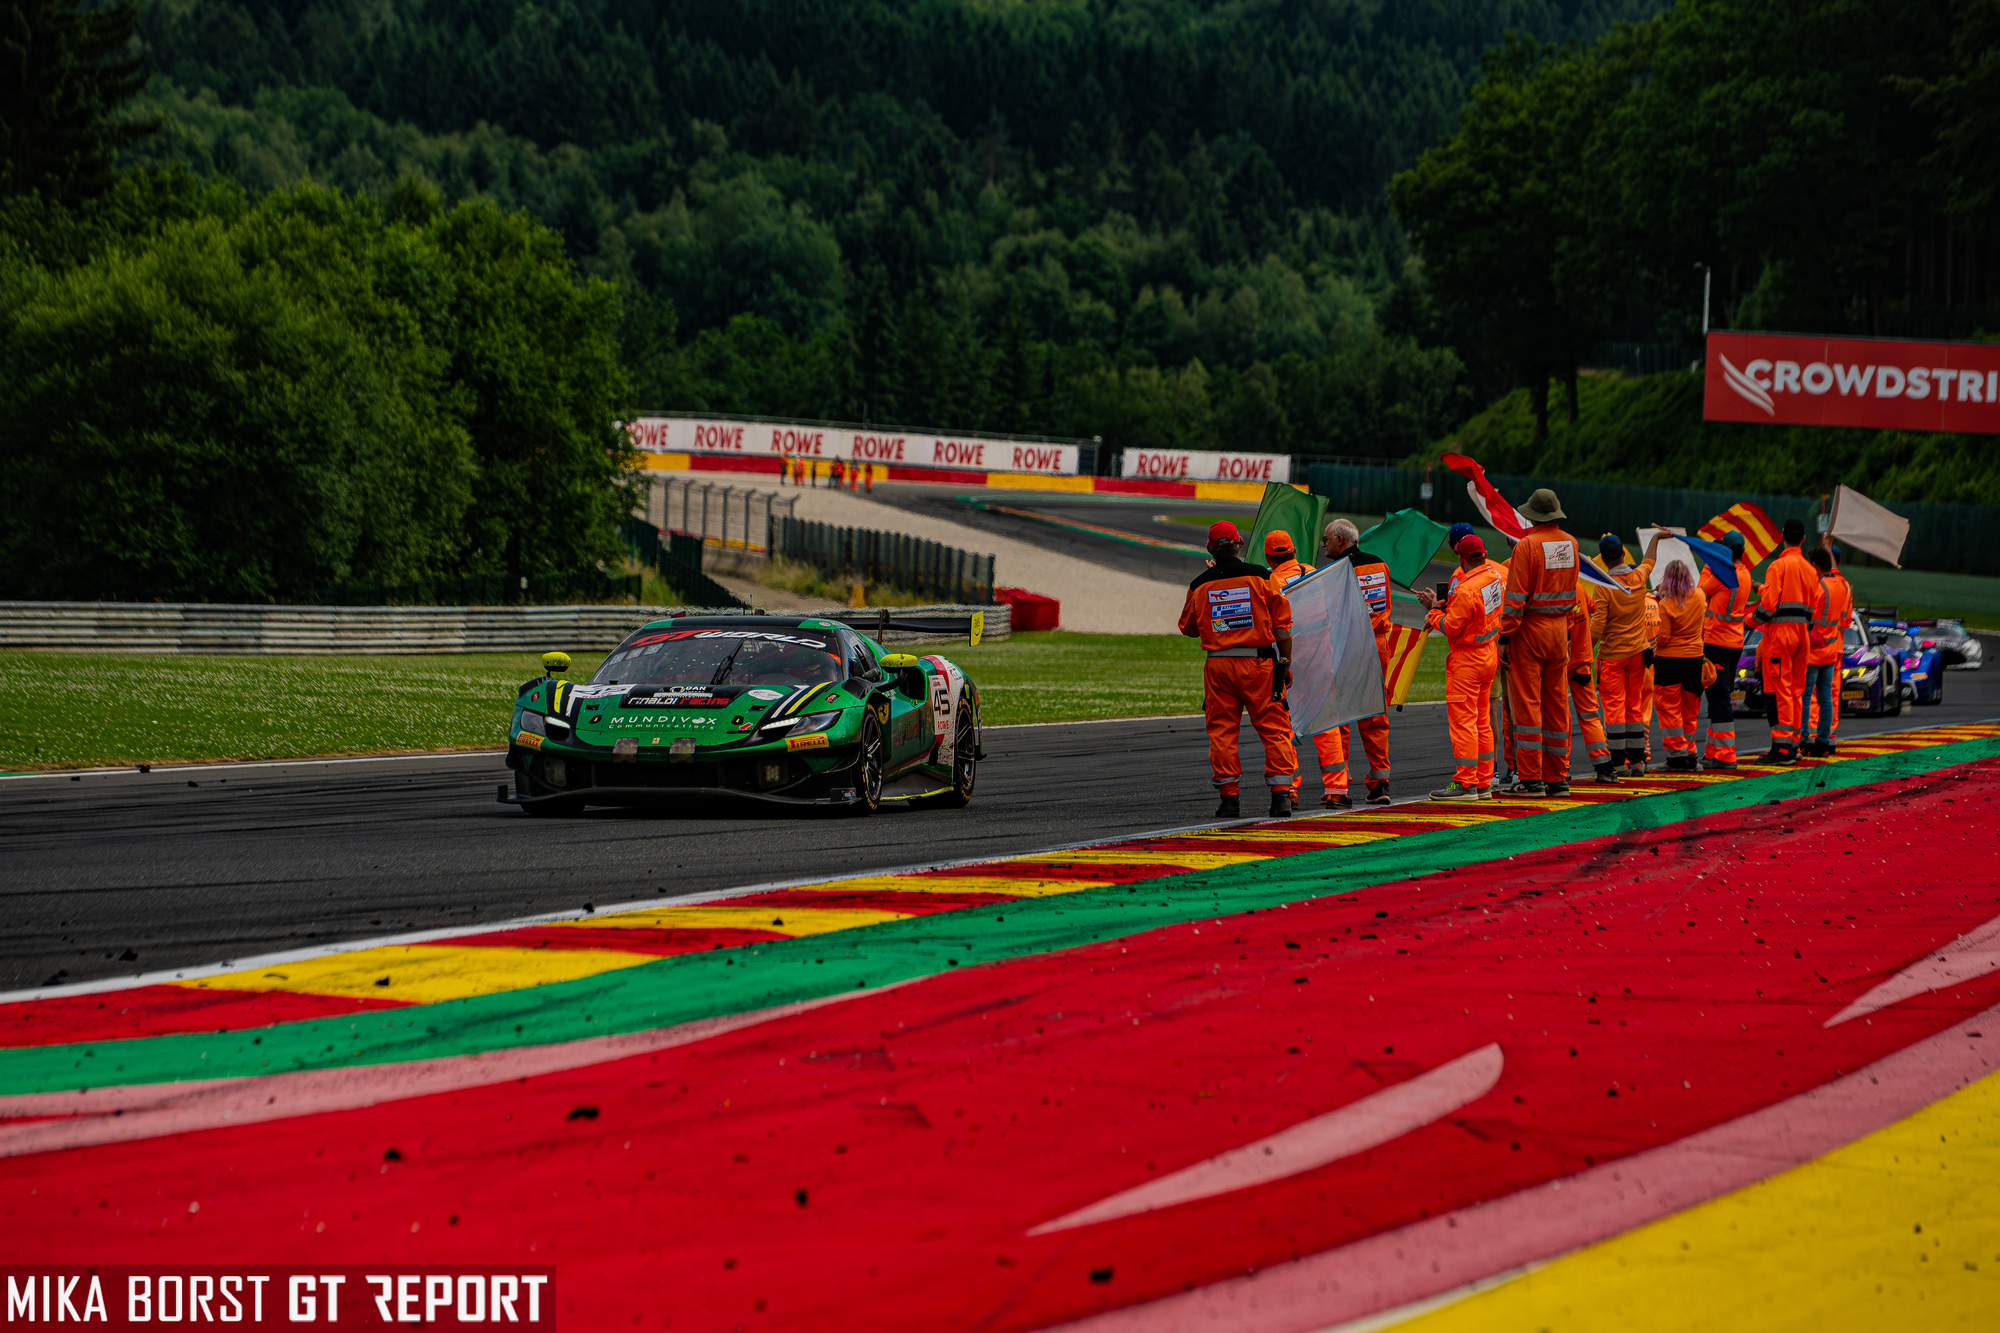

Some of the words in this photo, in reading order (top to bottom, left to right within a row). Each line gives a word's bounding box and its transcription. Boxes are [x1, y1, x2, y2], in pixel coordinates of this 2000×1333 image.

[1745, 358, 2000, 403] CROWDSTRI
[694, 423, 744, 449] ROWE
[771, 429, 824, 454] ROWE
[852, 435, 905, 460] ROWE
[933, 439, 985, 465] ROWE
[1012, 446, 1063, 470] ROWE
[1136, 452, 1189, 477] ROWE
[1216, 456, 1273, 479] ROWE
[694, 631, 826, 648] WORLD
[679, 698, 730, 706] racing
[934, 689, 951, 715] 45
[937, 720, 949, 731] ROWE
[518, 733, 541, 748] PIRELLI
[789, 735, 826, 749] PIRELLI
